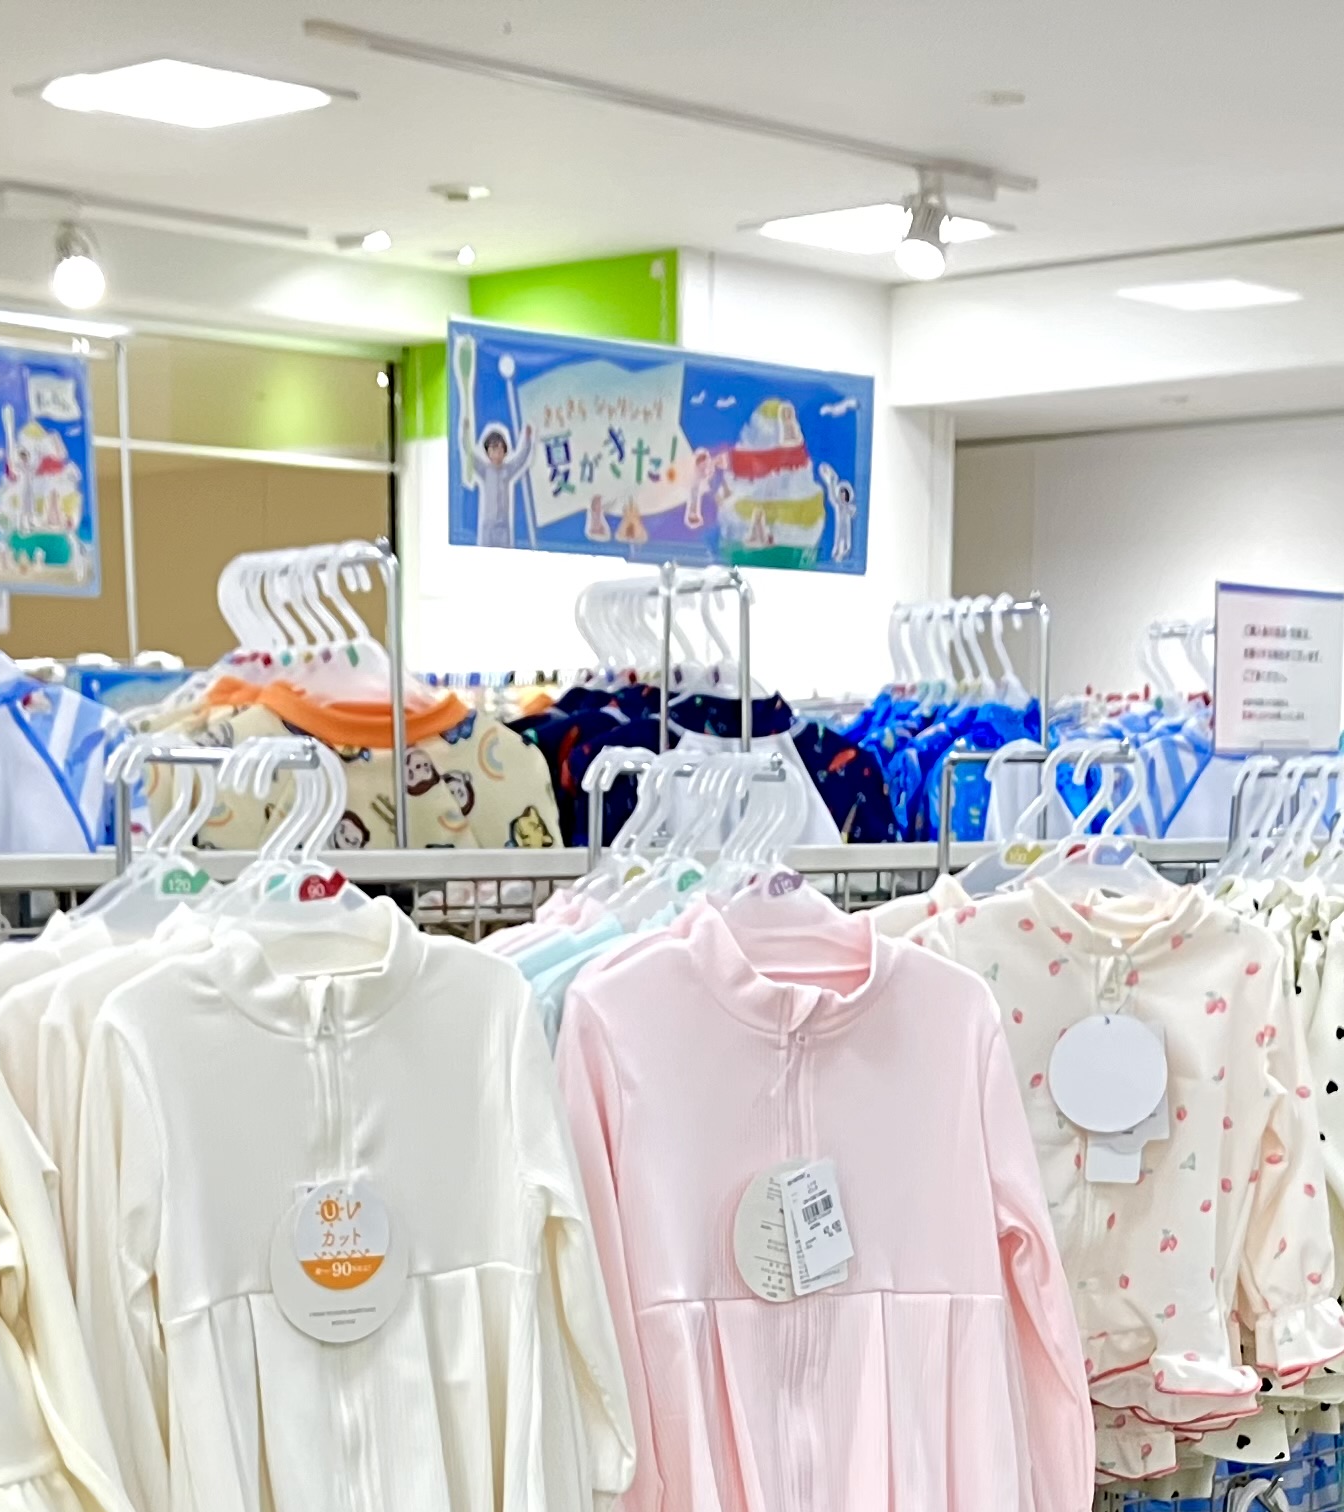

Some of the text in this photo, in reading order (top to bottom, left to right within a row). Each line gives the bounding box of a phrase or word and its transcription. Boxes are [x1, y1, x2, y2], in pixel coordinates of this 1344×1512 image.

[307, 882, 325, 898] 90
[321, 1227, 362, 1247] カット
